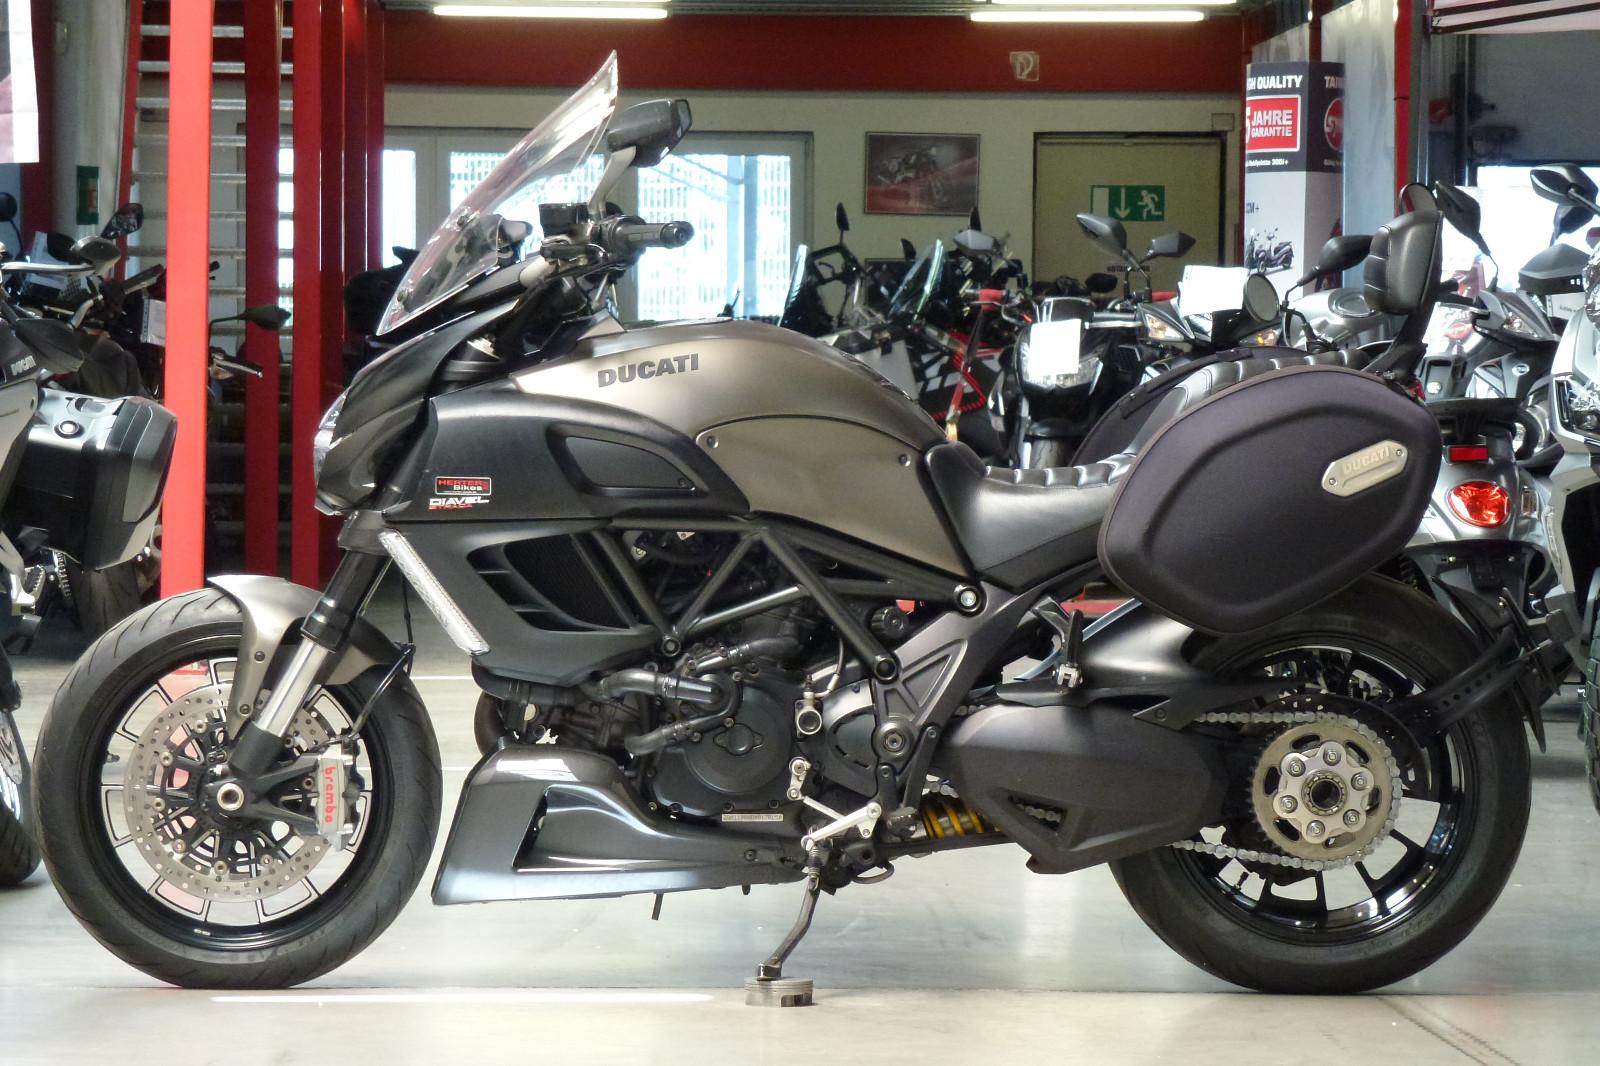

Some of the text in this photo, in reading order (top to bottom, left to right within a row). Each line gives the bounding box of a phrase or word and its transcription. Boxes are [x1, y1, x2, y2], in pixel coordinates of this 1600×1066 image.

[1246, 75, 1303, 90] GH QUALITY
[1252, 109, 1292, 126] JAHRE
[1251, 127, 1292, 138] GARANTIE
[598, 353, 699, 388] DUCATI
[1344, 446, 1389, 473] DUCATI
[429, 496, 490, 506] DIAVEL
[324, 766, 337, 823] brembo
